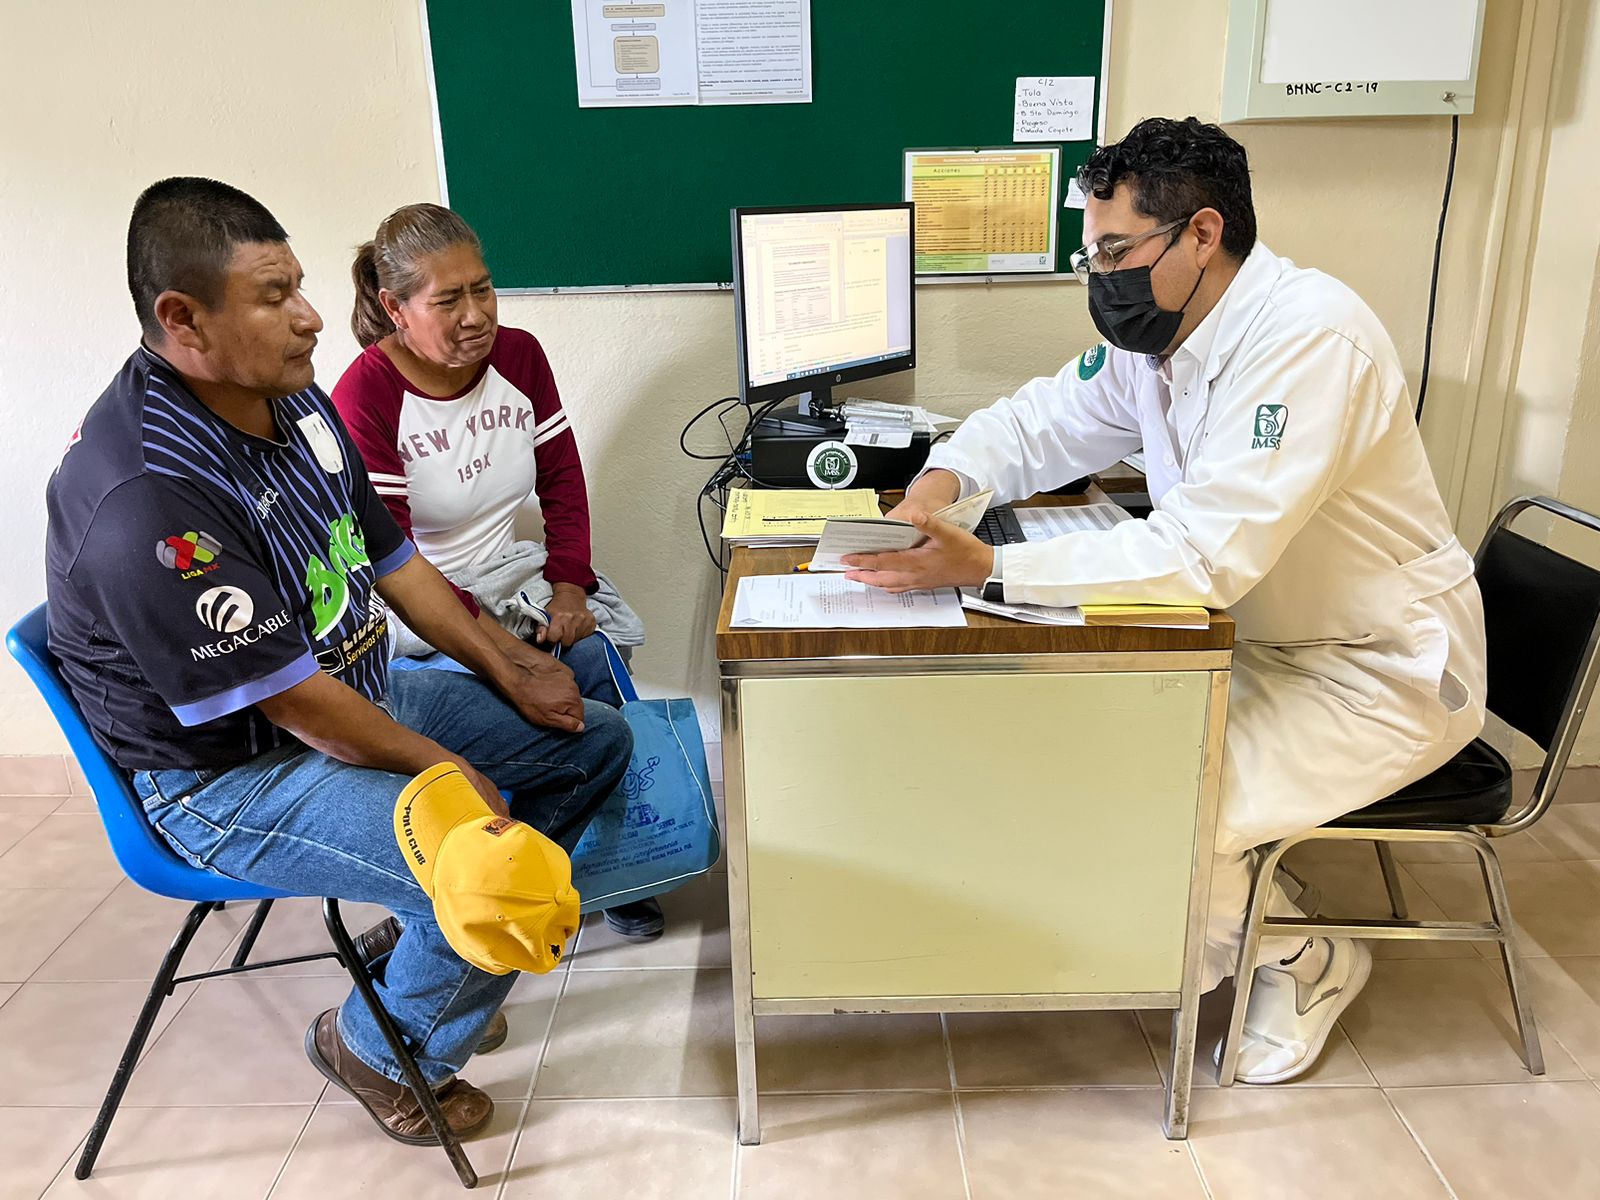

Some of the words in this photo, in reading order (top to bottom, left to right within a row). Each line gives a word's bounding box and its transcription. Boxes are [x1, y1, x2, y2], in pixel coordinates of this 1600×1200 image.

[398, 428, 451, 466] NEW
[466, 405, 532, 437] YORK
[1251, 437, 1281, 451] IMSS
[457, 452, 492, 483] 199X
[181, 568, 205, 580] LIGA
[190, 609, 292, 662] MEGACABLE
[346, 634, 376, 665] Servicios
[408, 837, 426, 866] CLUB
